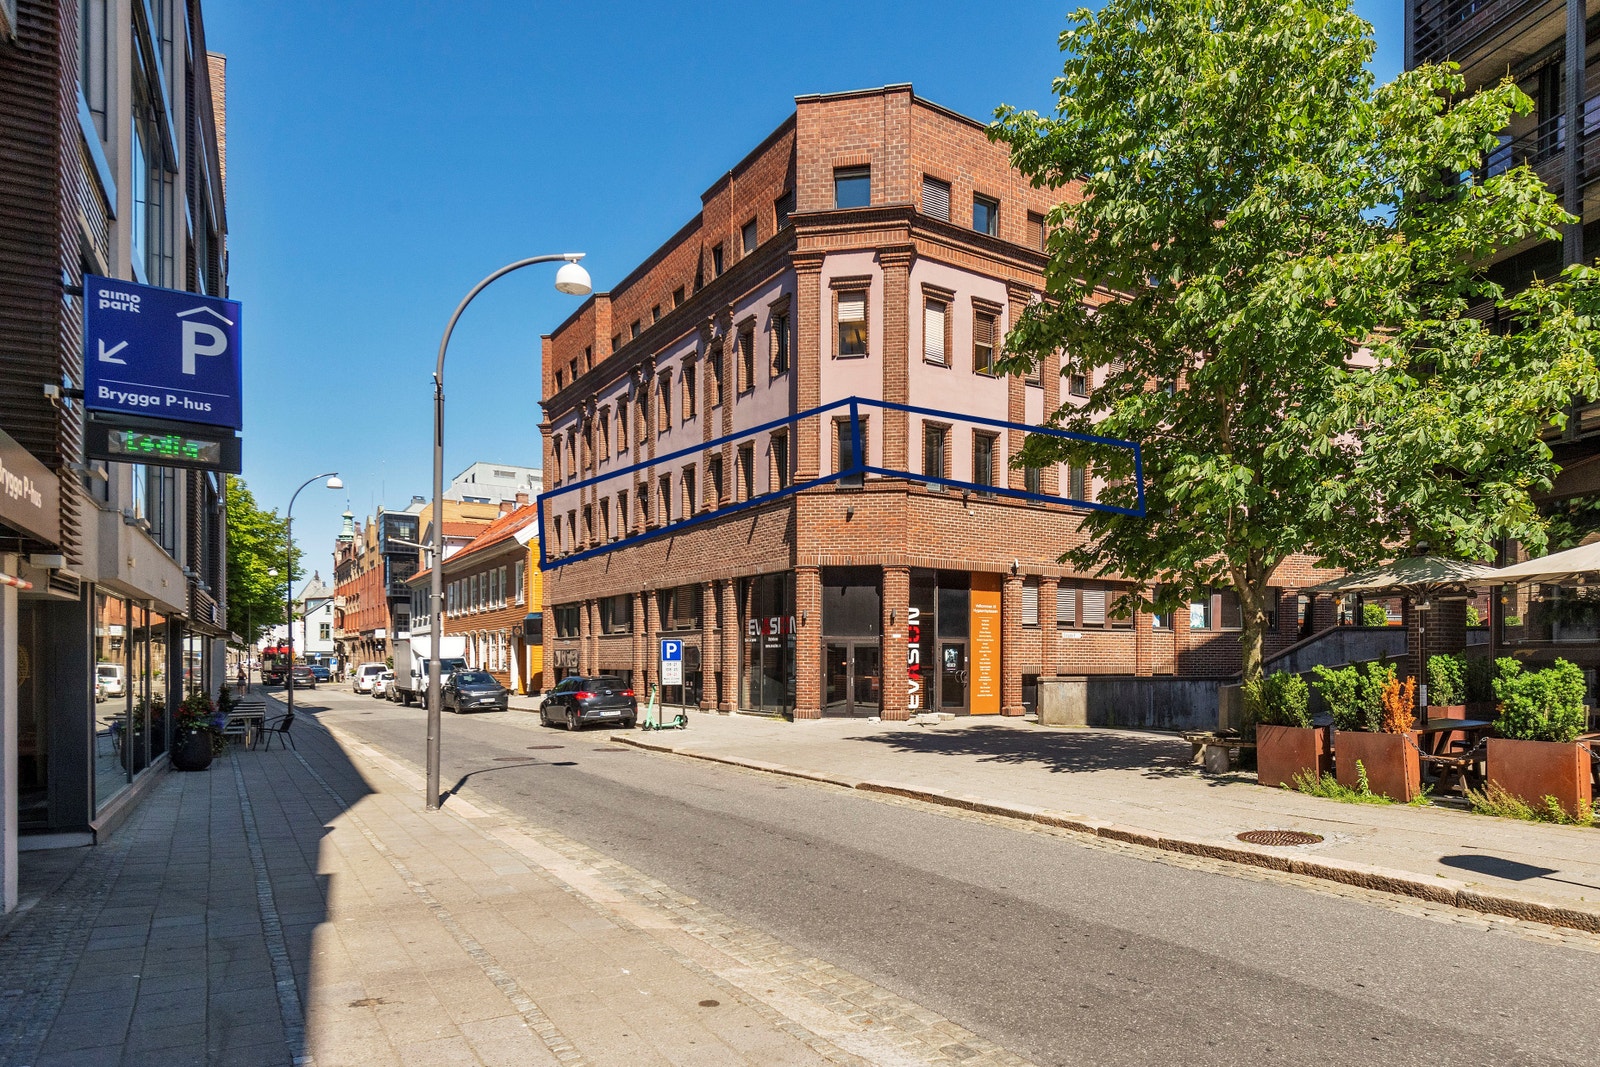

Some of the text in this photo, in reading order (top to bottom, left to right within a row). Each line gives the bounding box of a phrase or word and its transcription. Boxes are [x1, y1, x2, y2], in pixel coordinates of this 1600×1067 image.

[98, 289, 141, 303] aimo
[99, 299, 141, 313] park
[181, 320, 228, 375] P
[98, 386, 212, 412] Brygga P-hus
[127, 430, 198, 458] Ledig
[666, 642, 678, 659] P
